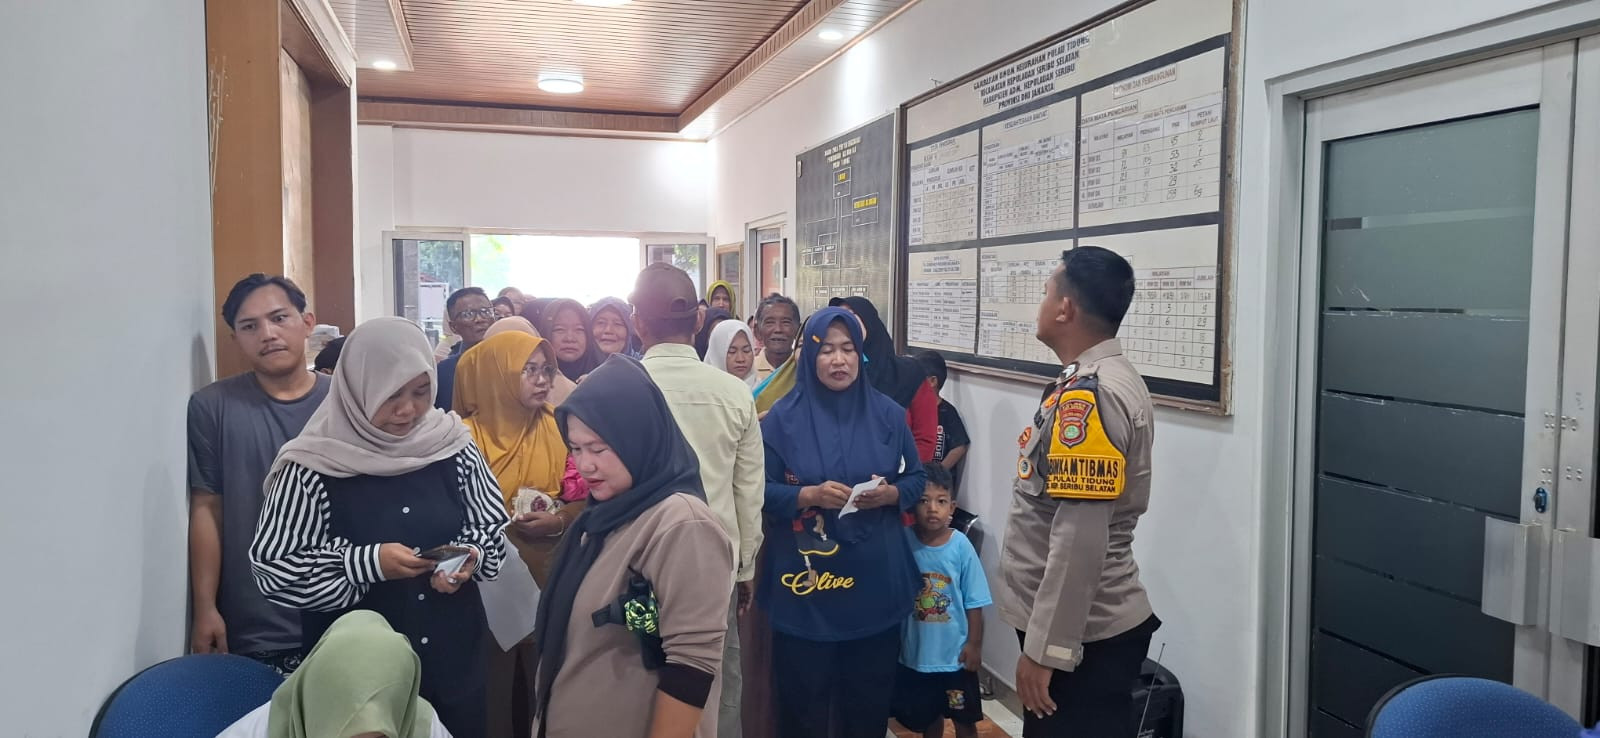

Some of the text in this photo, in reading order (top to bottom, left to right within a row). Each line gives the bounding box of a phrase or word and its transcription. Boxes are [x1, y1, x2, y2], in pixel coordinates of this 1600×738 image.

[1047, 45, 1065, 59] PULAU
[1066, 35, 1090, 51] TIDUNG
[1036, 61, 1055, 75] SERIBU
[1056, 50, 1080, 66] SELATAN
[1023, 73, 1053, 90] KEPULAUAN
[1055, 63, 1075, 78] SERIBU
[1031, 83, 1054, 99] JAKARTA
[1053, 475, 1077, 483] PULAU
[1081, 477, 1115, 486] TIDUNG
[1060, 482, 1084, 491] SERIBU
[1085, 484, 1116, 493] SELATAN
[781, 570, 855, 596] Olive
